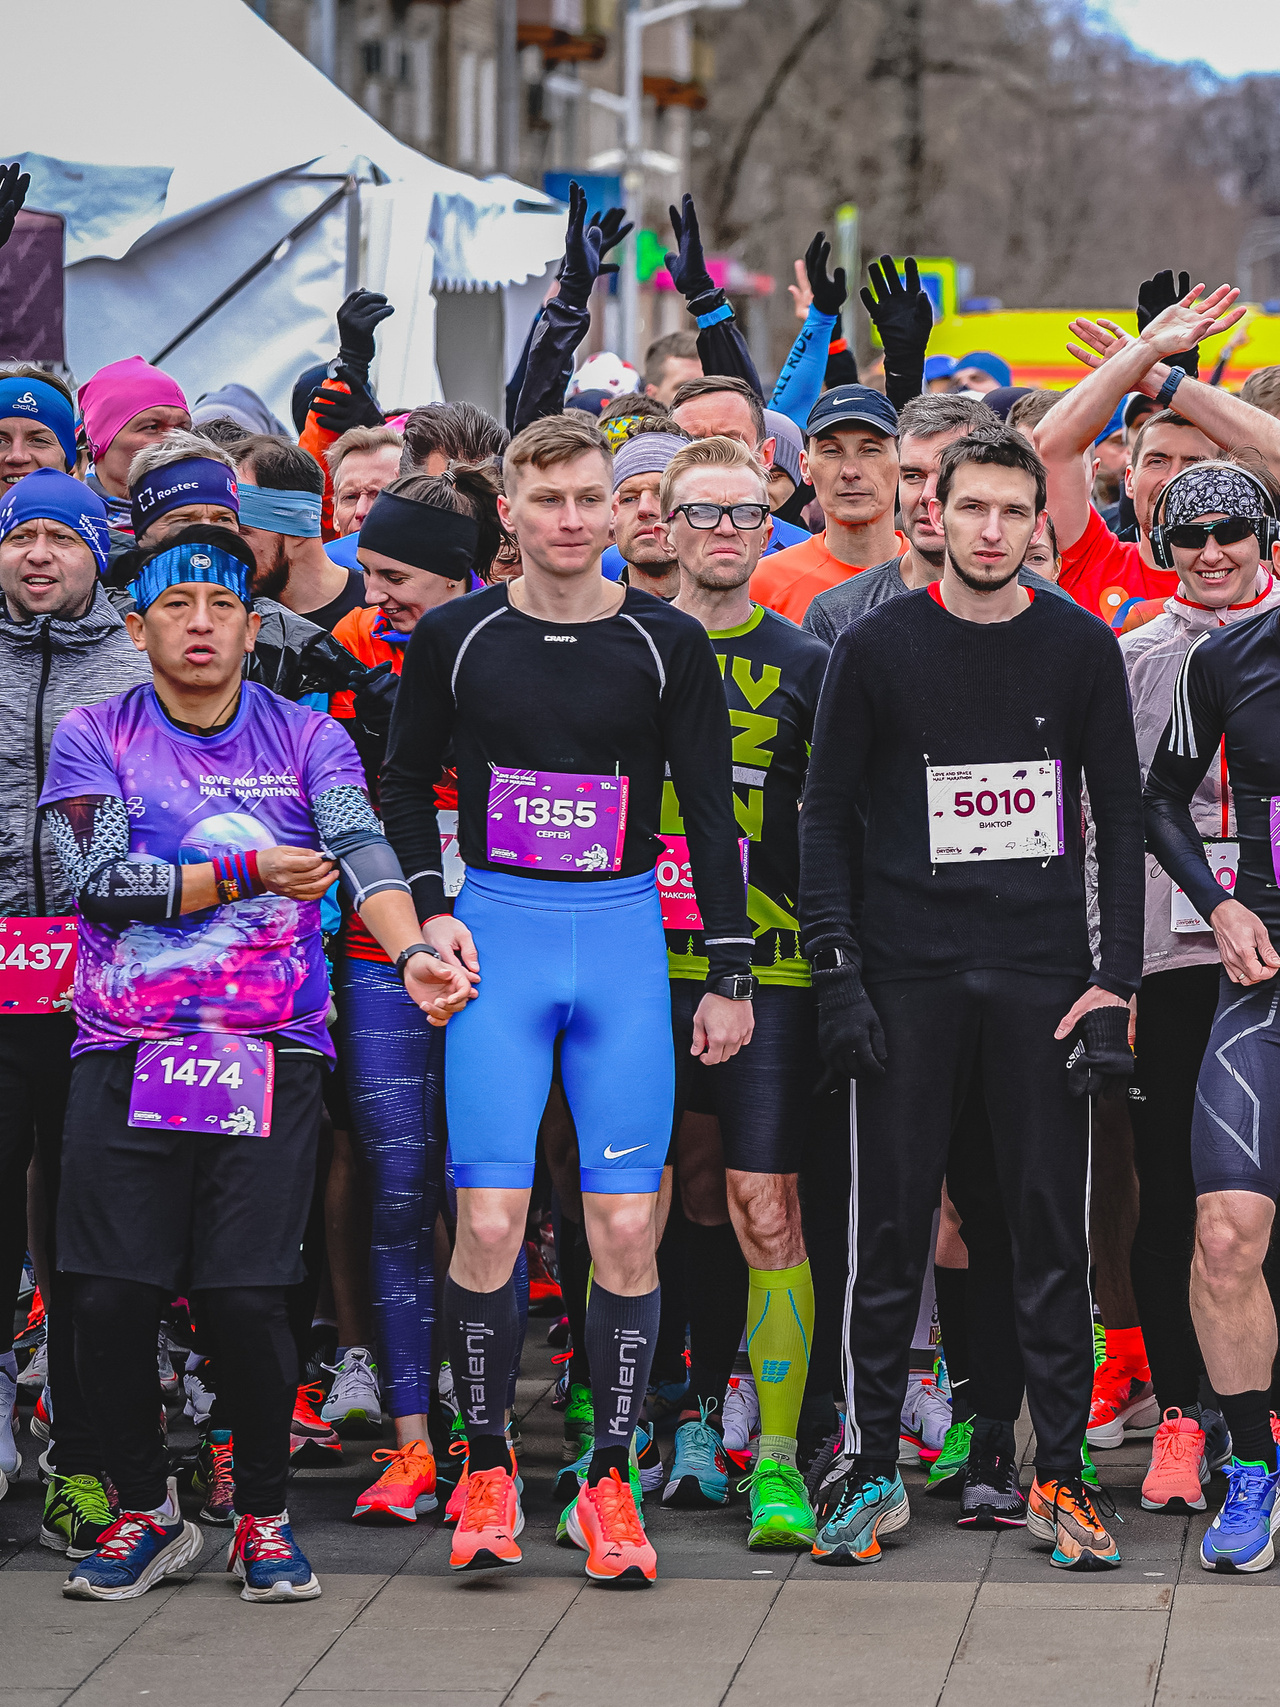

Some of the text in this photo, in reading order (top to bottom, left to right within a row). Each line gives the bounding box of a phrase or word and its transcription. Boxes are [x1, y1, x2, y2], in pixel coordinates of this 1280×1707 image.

[772, 328, 813, 405] ALL RIDE
[157, 480, 200, 500] Rostec
[1038, 767, 1045, 775] 5
[199, 774, 299, 788] LOVE AND SPACE
[600, 782, 611, 790] 10
[199, 785, 300, 798] HALF MARATHON
[953, 788, 1036, 818] 5010
[513, 796, 597, 828] 1355
[979, 820, 1013, 829] ВИКТОР
[536, 830, 571, 840] СЕРГЕЙ
[661, 891, 697, 900] МАКСИМ
[0, 943, 73, 970] 437
[160, 1056, 244, 1089] 1474
